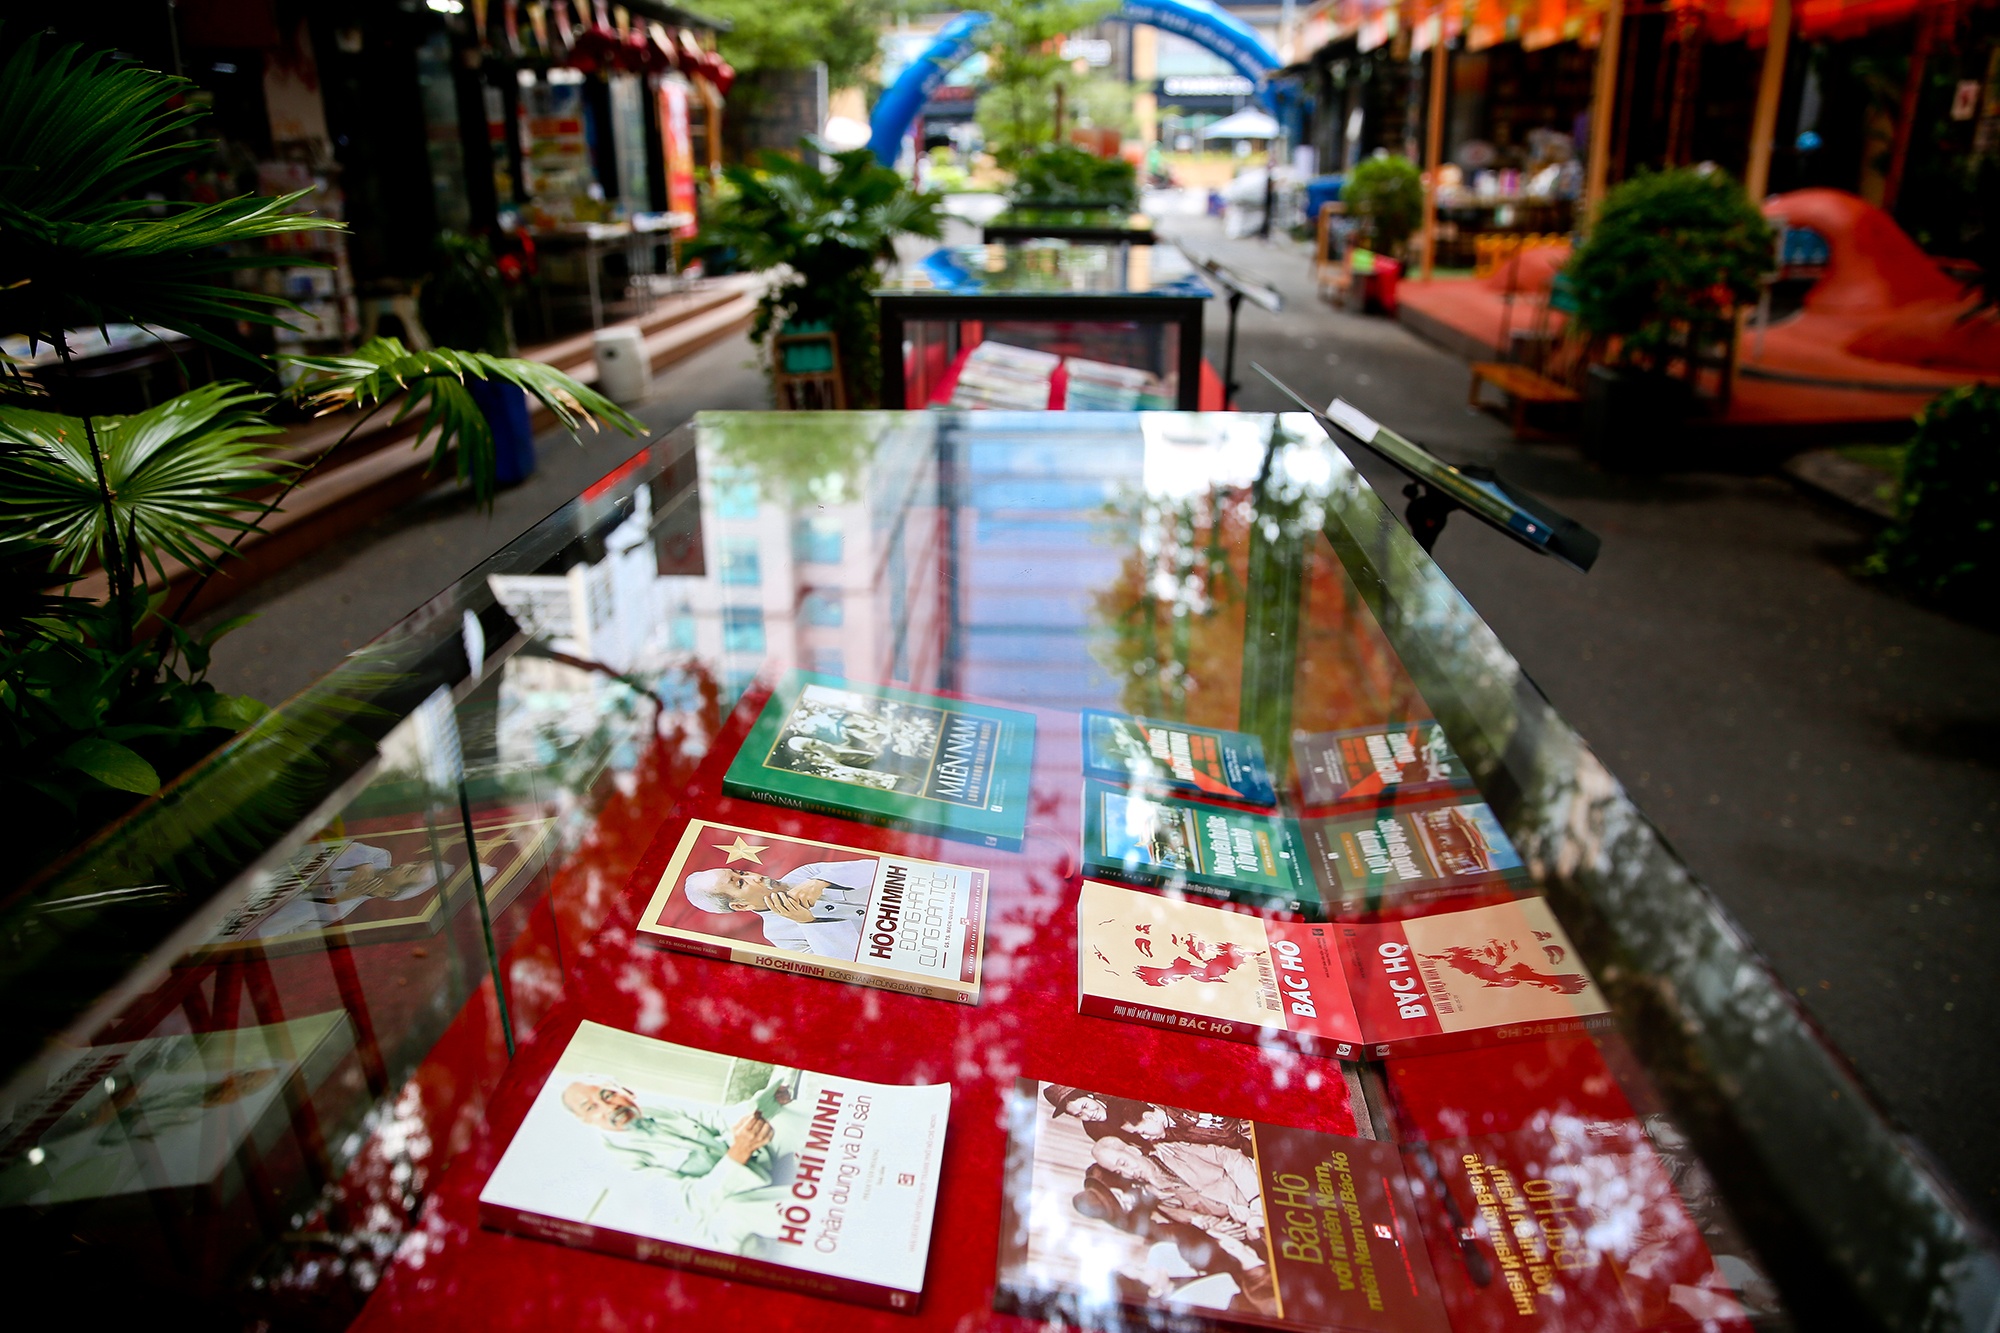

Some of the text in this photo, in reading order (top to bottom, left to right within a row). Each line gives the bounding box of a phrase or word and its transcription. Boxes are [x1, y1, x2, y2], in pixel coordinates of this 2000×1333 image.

[935, 719, 979, 799] MIỀN NAM
[751, 790, 802, 808] MIỀN NAM
[869, 865, 908, 960] HỒ CHÍ MINH
[898, 876, 927, 950] ĐỒNG HÀNH
[918, 872, 948, 967] CÙNG DÂN TỘC
[755, 955, 825, 977] HỒ CHÍ MINH
[828, 969, 932, 995] ĐỒNG HÀNH CÙNG DÂN TỘC
[1269, 940, 1317, 1018] BÁC HỒ
[1113, 1005, 1127, 1017] PHỤ
[1126, 1006, 1137, 1018] NỮ
[1136, 1008, 1152, 1020] MIỀN
[1151, 1012, 1165, 1023] NAM
[1178, 1016, 1206, 1030] BÁC
[1210, 1021, 1233, 1035] HỒ
[844, 1121, 864, 1139] Di
[848, 1095, 872, 1121] sản
[776, 1089, 844, 1245] HỒ CHÍ MINH
[841, 1142, 860, 1160] và
[832, 1164, 860, 1205] dung
[815, 1207, 845, 1253] Chân
[1272, 1170, 1324, 1264] Bác Hồ
[1314, 1161, 1355, 1290] với miền Nam,
[1331, 1150, 1384, 1311] miền Nam với Bác Hồ
